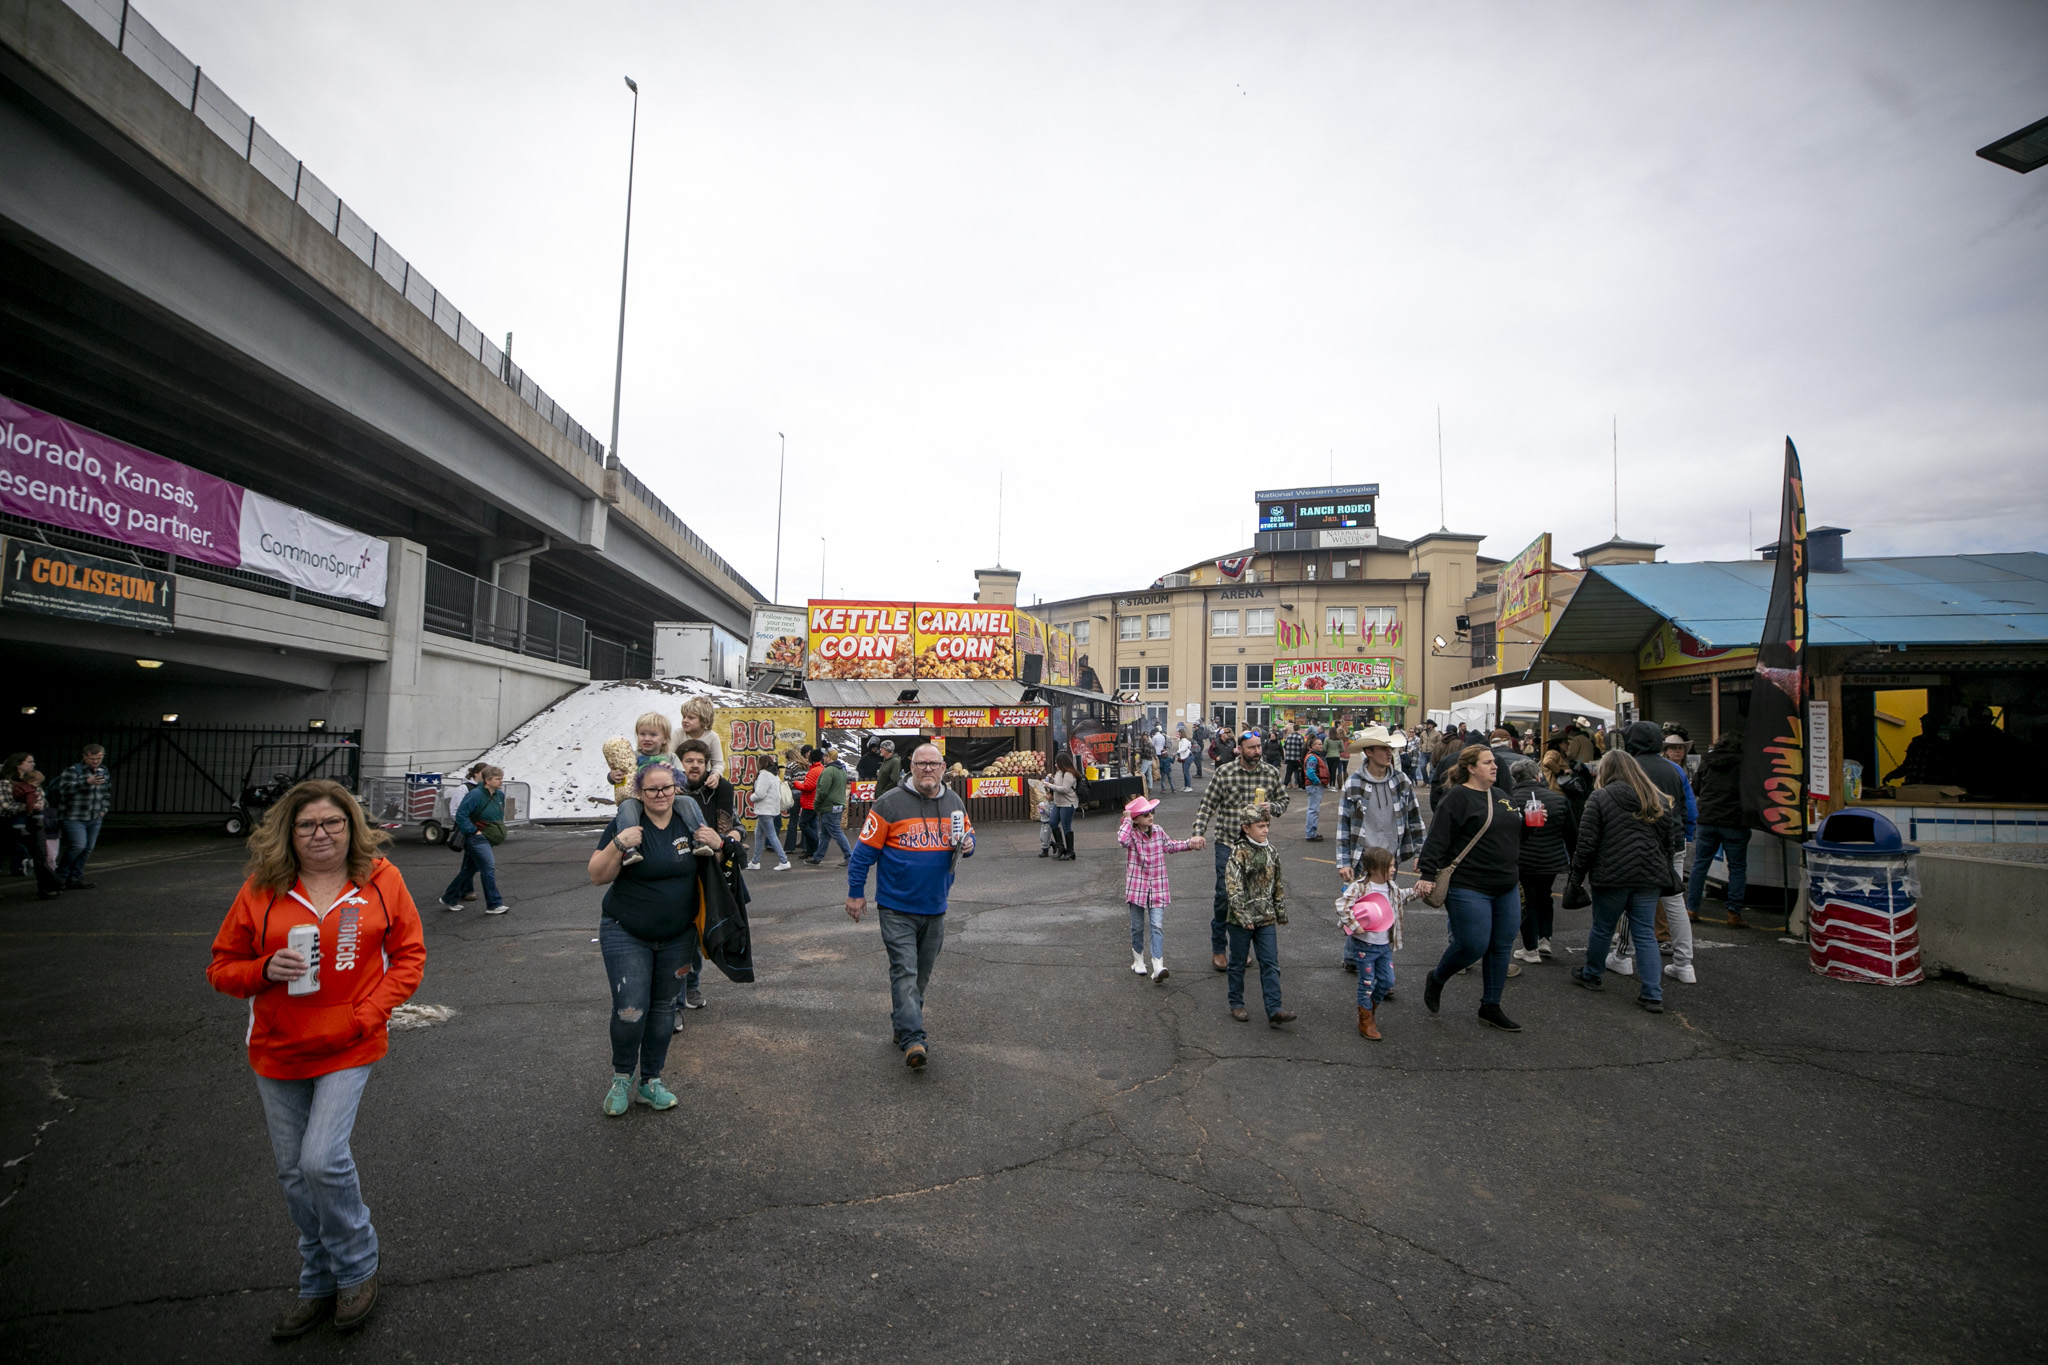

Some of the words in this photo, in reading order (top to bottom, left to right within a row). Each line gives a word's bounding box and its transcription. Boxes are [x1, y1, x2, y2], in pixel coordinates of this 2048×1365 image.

[114, 461, 199, 514] Kansas,
[1257, 491, 1293, 499] National
[1336, 486, 1377, 495] Complex
[1300, 506, 1334, 516] RANCH
[1337, 504, 1371, 514] RODEO
[127, 508, 214, 548] partner.
[1327, 530, 1360, 538] NATIONAL
[1332, 535, 1364, 543] WESTERN
[260, 533, 362, 579] CommonSpirit
[31, 557, 156, 603] COLISEUM
[1126, 594, 1169, 607] STADIUM
[1220, 589, 1264, 600] ARENA
[762, 612, 782, 620] Follow
[811, 608, 911, 633] KETTLE
[917, 611, 1011, 635] CARAMEL
[756, 631, 774, 640] Sysco
[820, 635, 897, 660] CORN
[936, 637, 995, 661] CORN
[1292, 660, 1334, 677] FUNNEL
[1336, 660, 1373, 677] CAKES
[829, 709, 870, 718] CARAMEL
[893, 709, 926, 718] KETTLE
[947, 709, 985, 718] CARAMEL
[1001, 708, 1042, 717] CRAZY
[837, 717, 863, 726] CORN
[896, 717, 921, 726] CORN
[955, 717, 979, 726] CORN
[1002, 716, 1039, 725] CORN
[731, 719, 775, 751] BIG
[1084, 732, 1118, 743] TURKEY
[1093, 743, 1115, 753] LEGS
[979, 778, 1010, 788] KETTLE
[982, 786, 1006, 796] CORN
[897, 831, 957, 848] BRONC
[335, 907, 360, 971] BRONCOS
